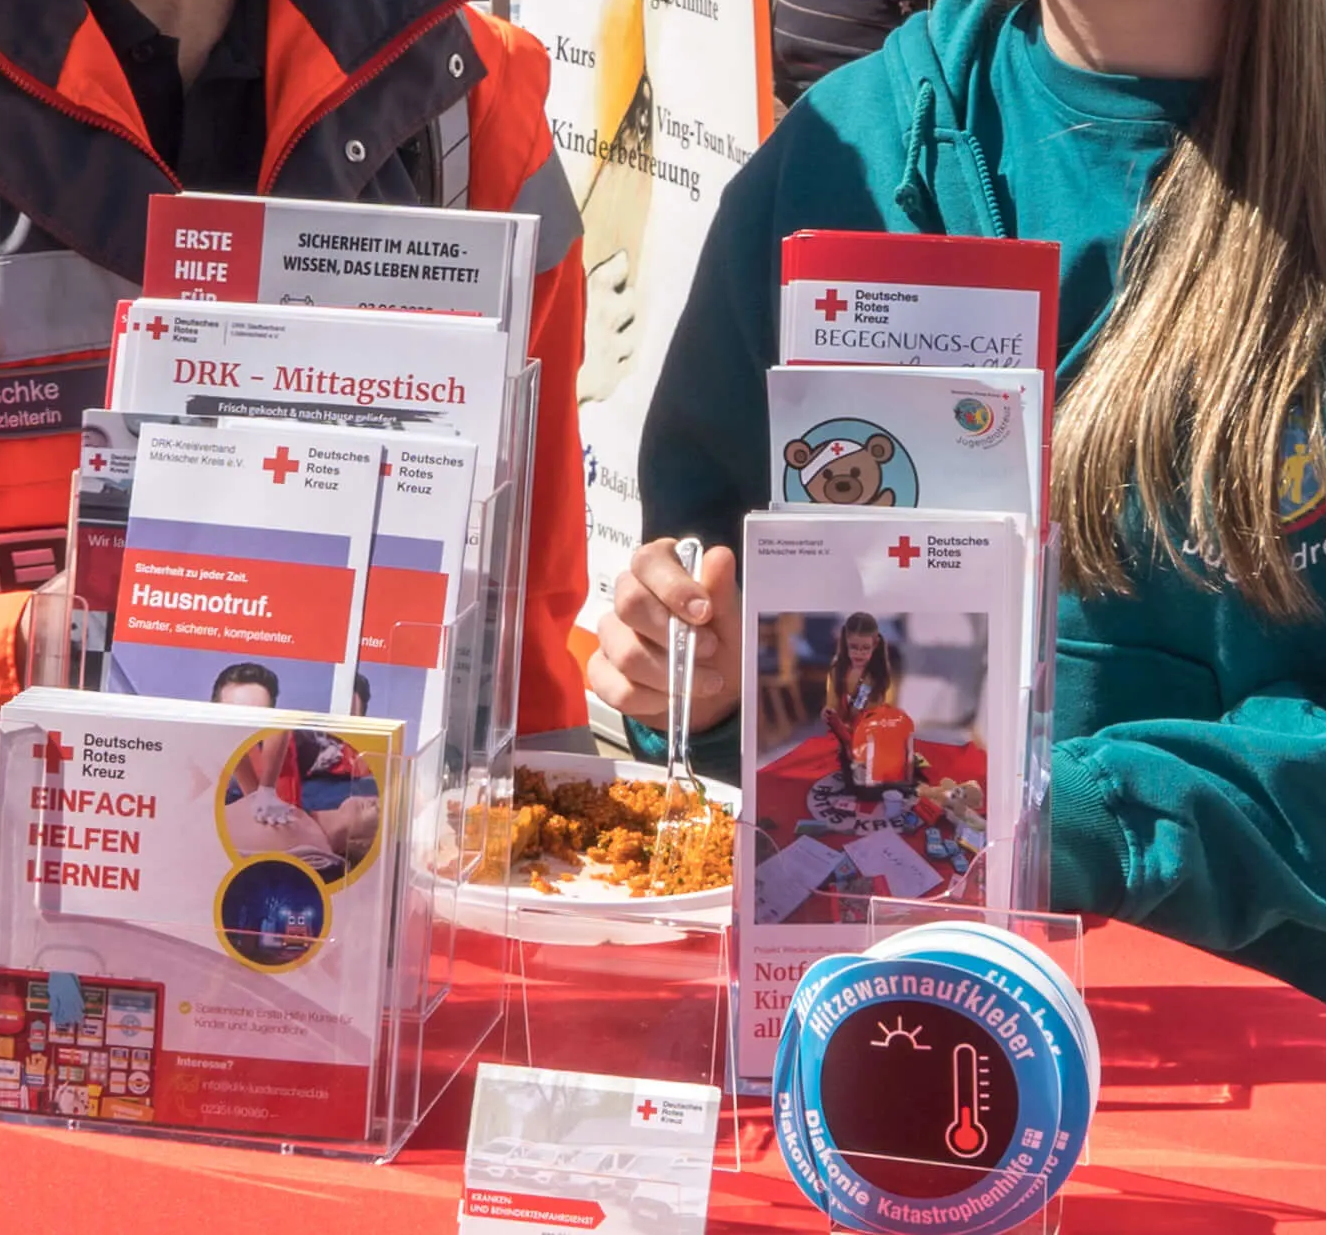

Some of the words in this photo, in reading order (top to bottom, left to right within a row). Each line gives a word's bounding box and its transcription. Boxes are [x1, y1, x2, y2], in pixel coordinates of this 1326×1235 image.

[555, 35, 597, 69] Kurs
[656, 105, 724, 160] Ving-Tsun
[551, 118, 701, 202] Kinderbetreuung
[175, 228, 233, 253] ERSTE
[297, 232, 382, 256] SICHERHEIT
[383, 237, 402, 255] IM
[406, 238, 461, 259] ALLTAG
[174, 258, 228, 283] HILFE
[283, 255, 341, 277] WISSEN,
[343, 260, 372, 276] DAS
[373, 261, 420, 279] LEBEN
[421, 265, 480, 284] RETTET!
[855, 289, 919, 303] Deutsches
[854, 301, 890, 313] Rotes
[174, 316, 220, 329] Deutsches
[854, 312, 890, 324] Kreuz
[174, 326, 199, 335] Rotes
[814, 328, 1024, 356] BEGEGNUNGS-CAFÉ
[173, 358, 241, 389] DRK
[272, 366, 467, 405] Mittagstisch
[218, 402, 248, 414] Frisch
[248, 405, 288, 418] gekocht
[289, 408, 298, 418] &
[299, 409, 323, 420] nach
[323, 410, 354, 422] Hause
[150, 437, 237, 454] DRK-Kreisverband
[149, 451, 199, 465] Märkischer
[307, 447, 371, 464] Deutsches
[400, 451, 465, 468] Deutsches
[306, 462, 341, 477] Rotes
[399, 466, 434, 481] Rotes
[304, 476, 339, 491] Kreuz
[396, 481, 433, 496] Kreuz
[87, 534, 111, 548] Wir
[927, 535, 990, 547] Deutsches
[927, 547, 962, 558] Rotes
[134, 562, 185, 578] Sicherheit
[185, 569, 199, 580] zu
[199, 570, 225, 584] jeder
[226, 570, 249, 584] Zeit.
[927, 558, 962, 570] Kreuz
[131, 582, 273, 619] Hausnotruf.
[128, 616, 173, 635] Smarter,
[175, 621, 221, 639] sicherer,
[223, 624, 295, 645] kompetenter.
[83, 732, 164, 752] Deutsches
[82, 748, 127, 764] Rotes
[81, 764, 126, 780] Kreuz
[30, 786, 157, 819] EINFACH
[27, 823, 141, 855] HELFEN
[26, 859, 141, 892] LERNEN
[194, 1017, 226, 1030] Kinder
[227, 1020, 248, 1031] und
[248, 1021, 308, 1036] Jugendliche
[808, 973, 1037, 1062] Hitzewarnaufkleber
[176, 1056, 234, 1070] Interesse?
[662, 1100, 703, 1112] Deutsches
[805, 1109, 871, 1207] Diakonie
[471, 1192, 513, 1205] KRANKEN-
[876, 1153, 1035, 1226] Katastrophenhilfe
[470, 1202, 489, 1214] UND
[490, 1205, 594, 1226] BEHINDERTENFAHRDIENST
